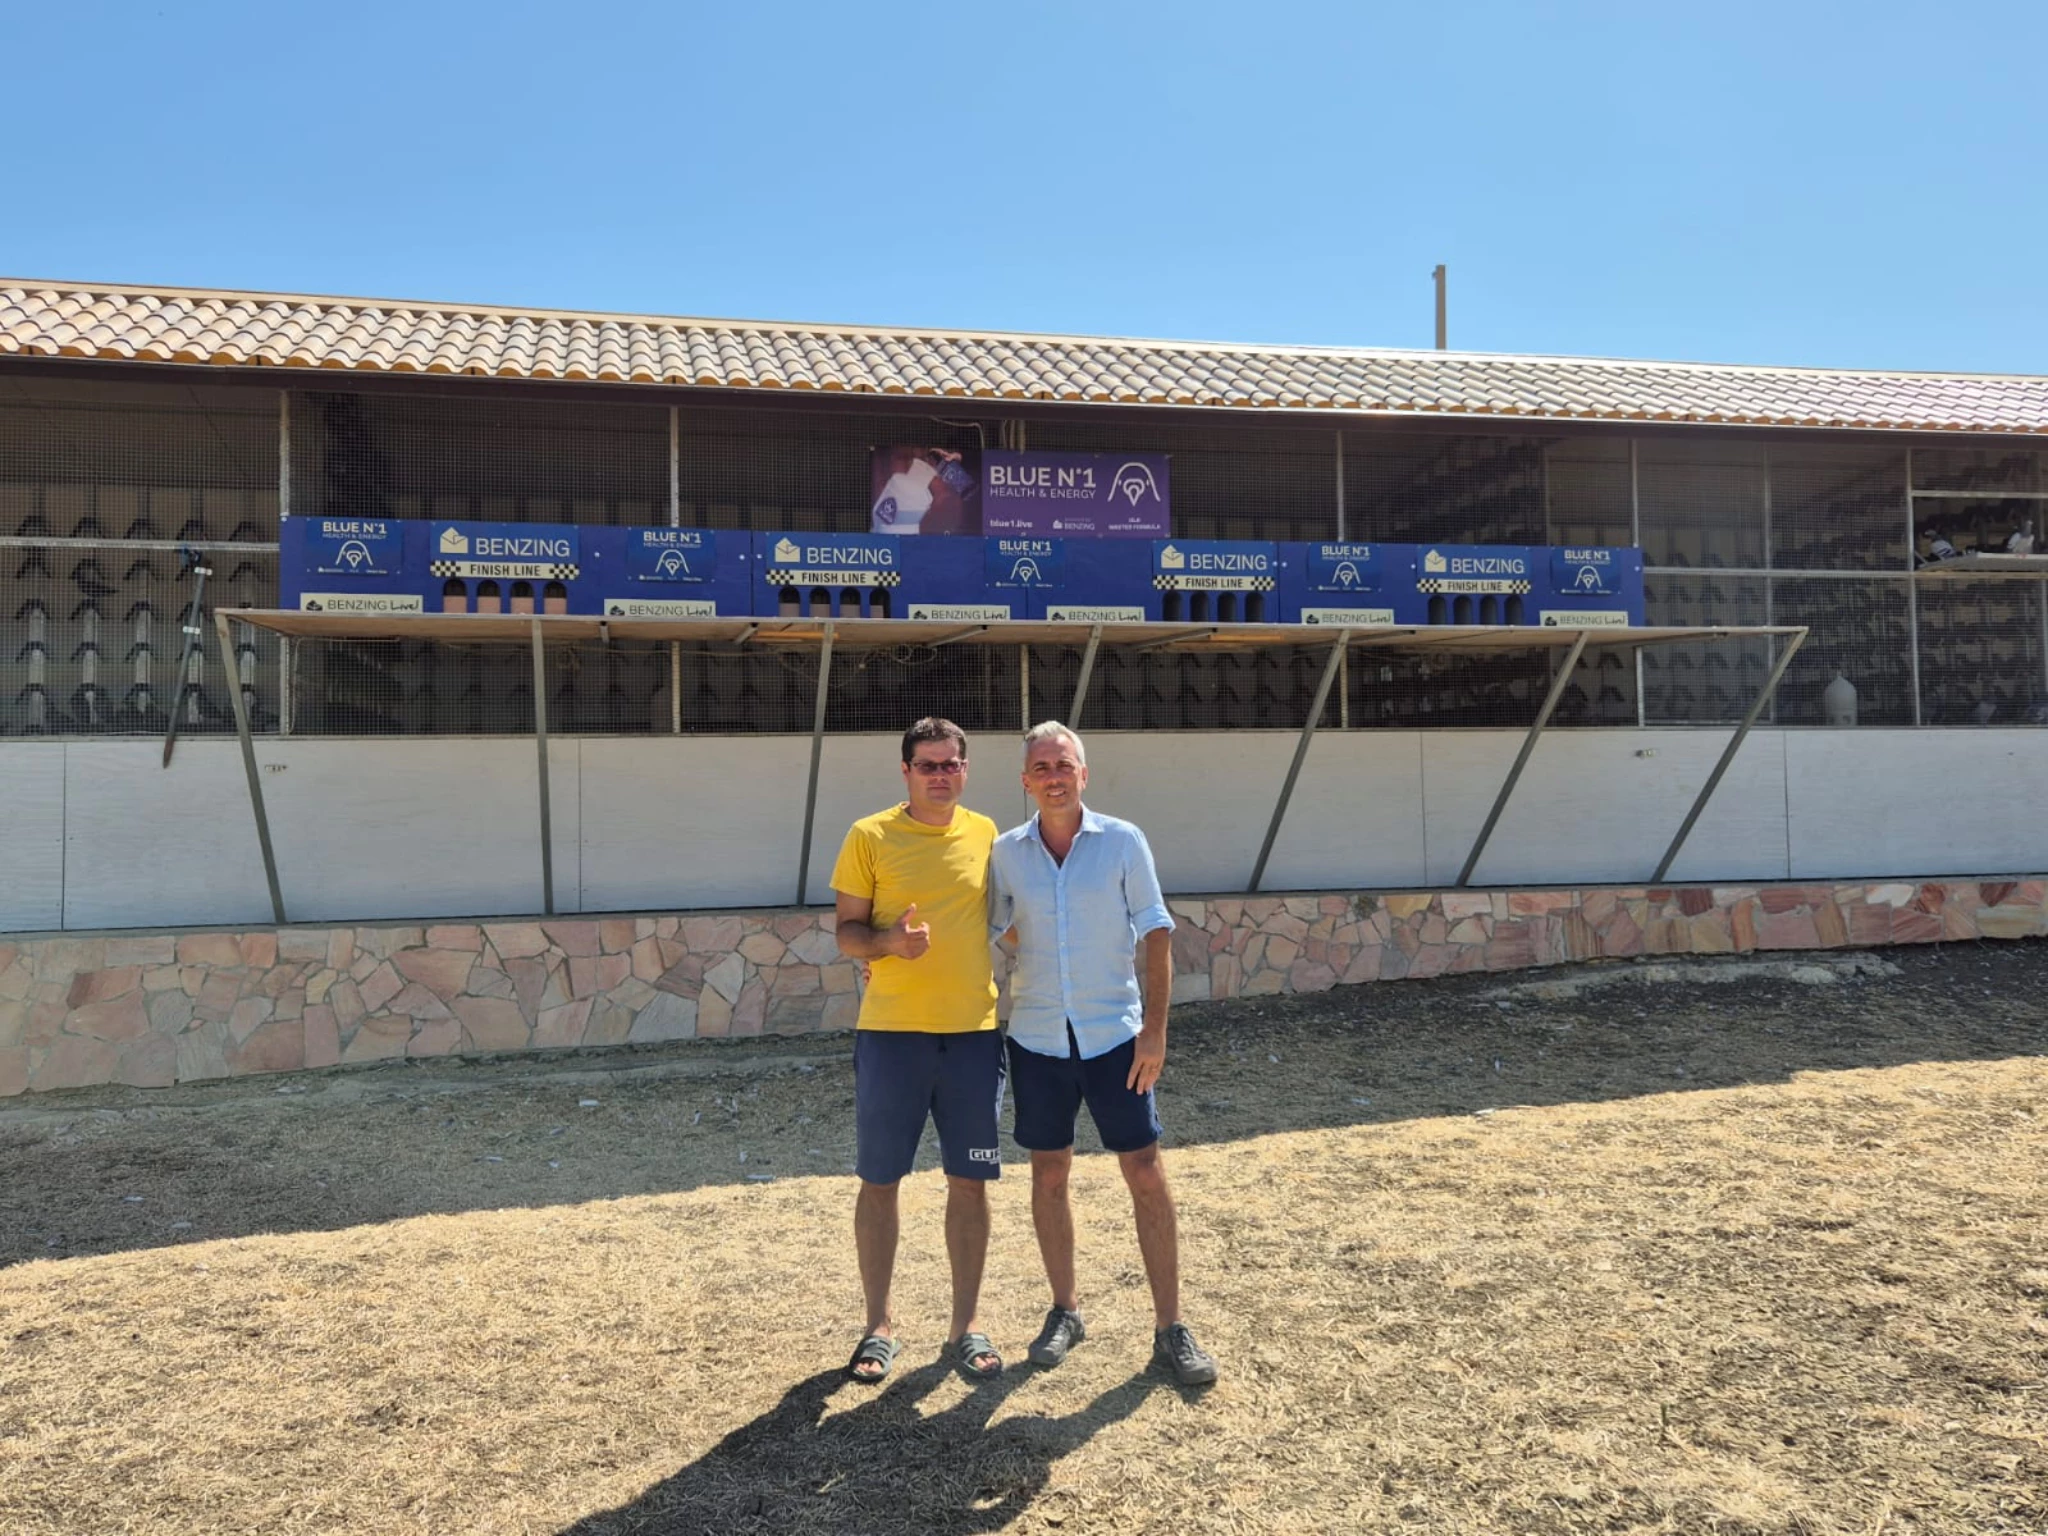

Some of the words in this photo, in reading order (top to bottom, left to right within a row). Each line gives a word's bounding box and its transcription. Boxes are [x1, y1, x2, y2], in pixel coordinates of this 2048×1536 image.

[990, 466, 1051, 486] BLUE
[990, 487, 1035, 498] HEALTH
[1039, 488, 1047, 498] &
[1050, 488, 1096, 499] ENERGY
[323, 521, 360, 533] BLUE
[990, 519, 1033, 528] blue1.live
[643, 531, 677, 542] BLUE
[476, 538, 570, 557] BENZING
[999, 540, 1030, 551] BLUE
[1322, 545, 1350, 555] BLUE
[807, 547, 892, 565] BENZING
[1564, 549, 1592, 559] BLUE
[1190, 554, 1267, 571] BENZING
[1451, 558, 1525, 574] BENZING
[470, 564, 511, 576] FINISH
[514, 565, 541, 577] LINE
[802, 572, 839, 584] FINISH
[841, 573, 867, 584] LINE
[1185, 578, 1218, 588] FINISH
[1220, 579, 1243, 588] LINE
[1448, 581, 1478, 591] FINISH
[1481, 582, 1502, 592] LINE
[328, 599, 387, 611] BENZING
[629, 604, 684, 616] BENZING
[932, 610, 980, 620] BENZING
[1069, 611, 1116, 621] BENZING
[1322, 613, 1367, 623] BENZING
